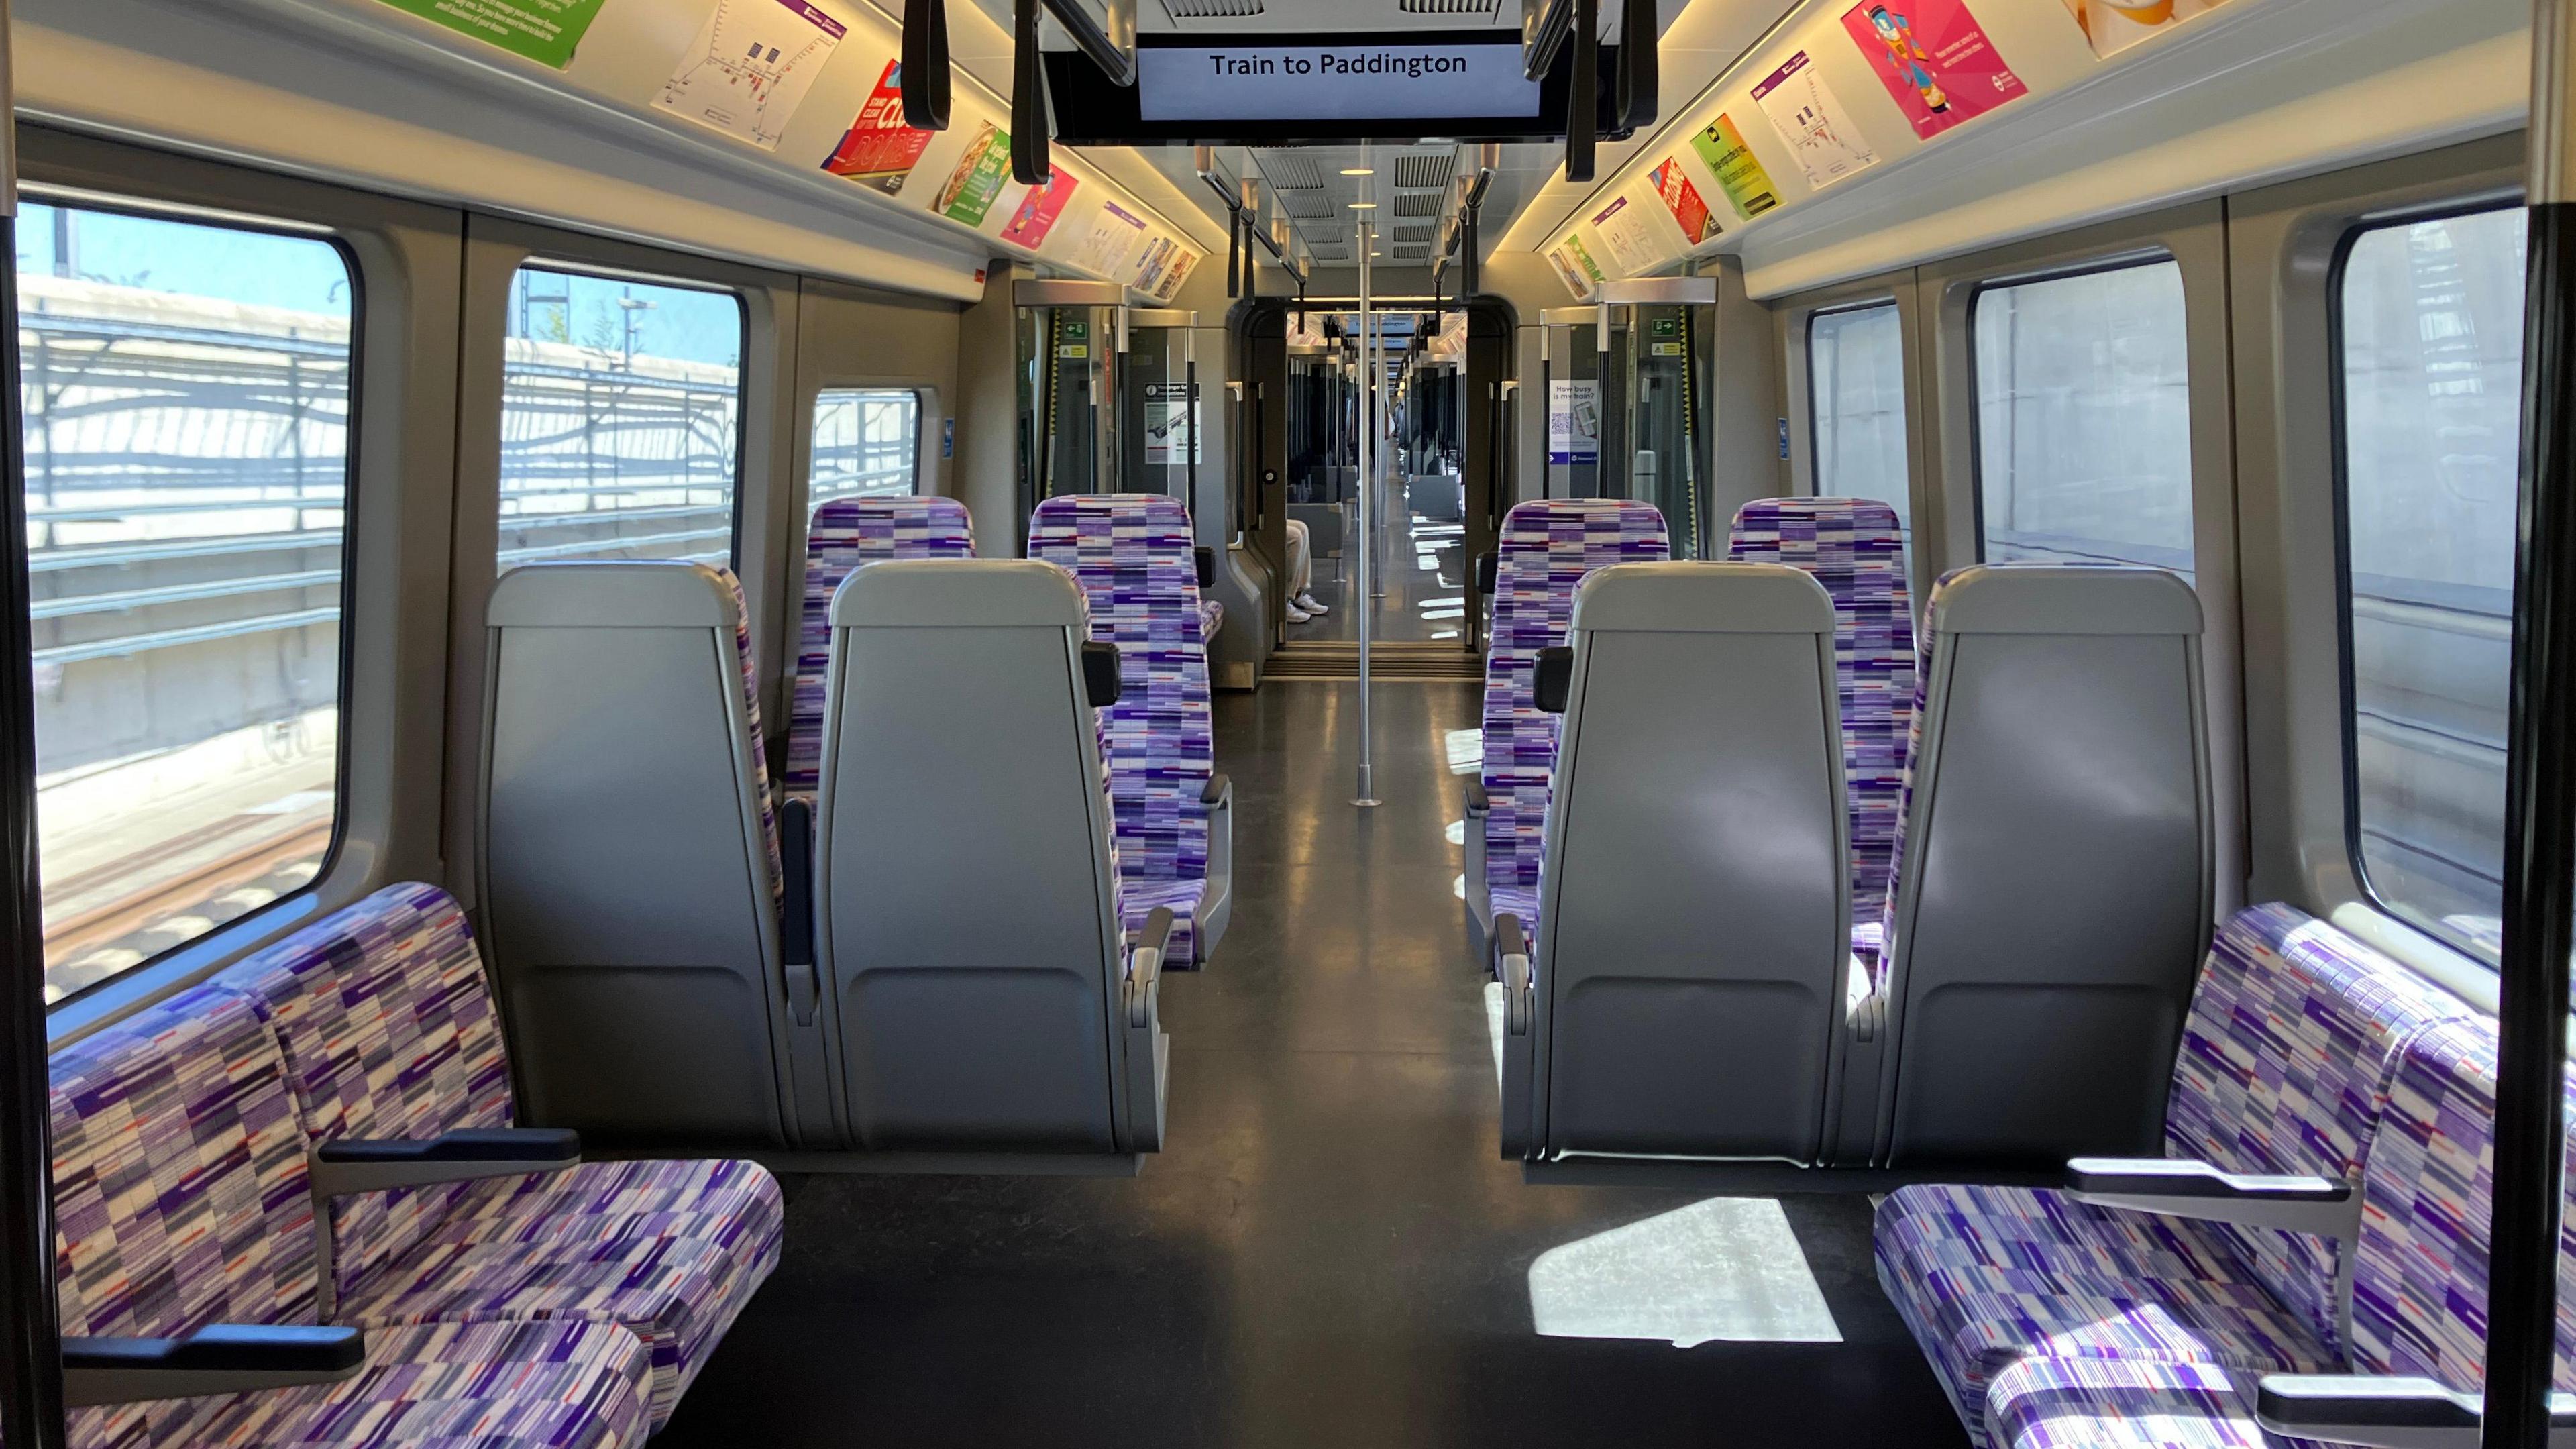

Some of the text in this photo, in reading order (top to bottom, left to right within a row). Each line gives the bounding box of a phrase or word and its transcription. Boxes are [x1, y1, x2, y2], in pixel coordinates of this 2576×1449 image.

[1210, 53, 1467, 78] Train to Paddington
[868, 97, 888, 107] STAND
